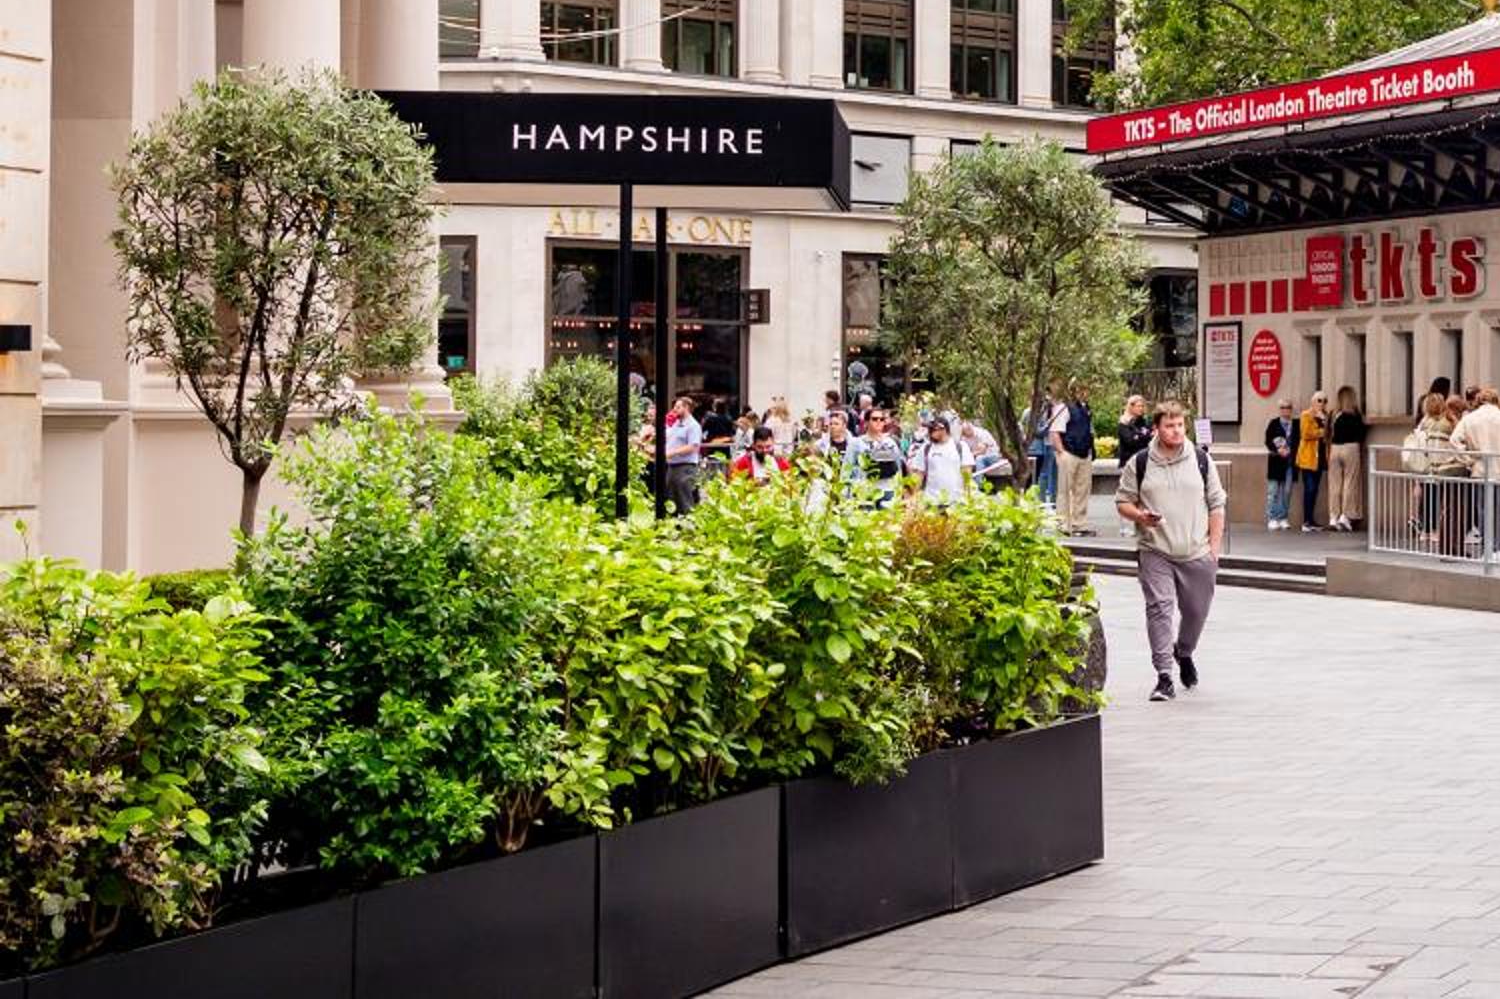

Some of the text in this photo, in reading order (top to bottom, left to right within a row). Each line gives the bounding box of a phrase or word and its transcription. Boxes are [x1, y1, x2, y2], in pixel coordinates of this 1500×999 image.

[1124, 116, 1156, 143] TKTS
[1169, 110, 1193, 135] The
[1195, 98, 1247, 131] Official
[1250, 91, 1304, 122] London
[1307, 85, 1368, 114] Theatre
[1370, 75, 1420, 102] Ticket
[1423, 60, 1475, 95] Booth
[512, 123, 764, 154] HAMPSHIRE
[546, 207, 602, 235] ALL
[687, 215, 753, 244] ONE
[1349, 227, 1482, 305] tkts
